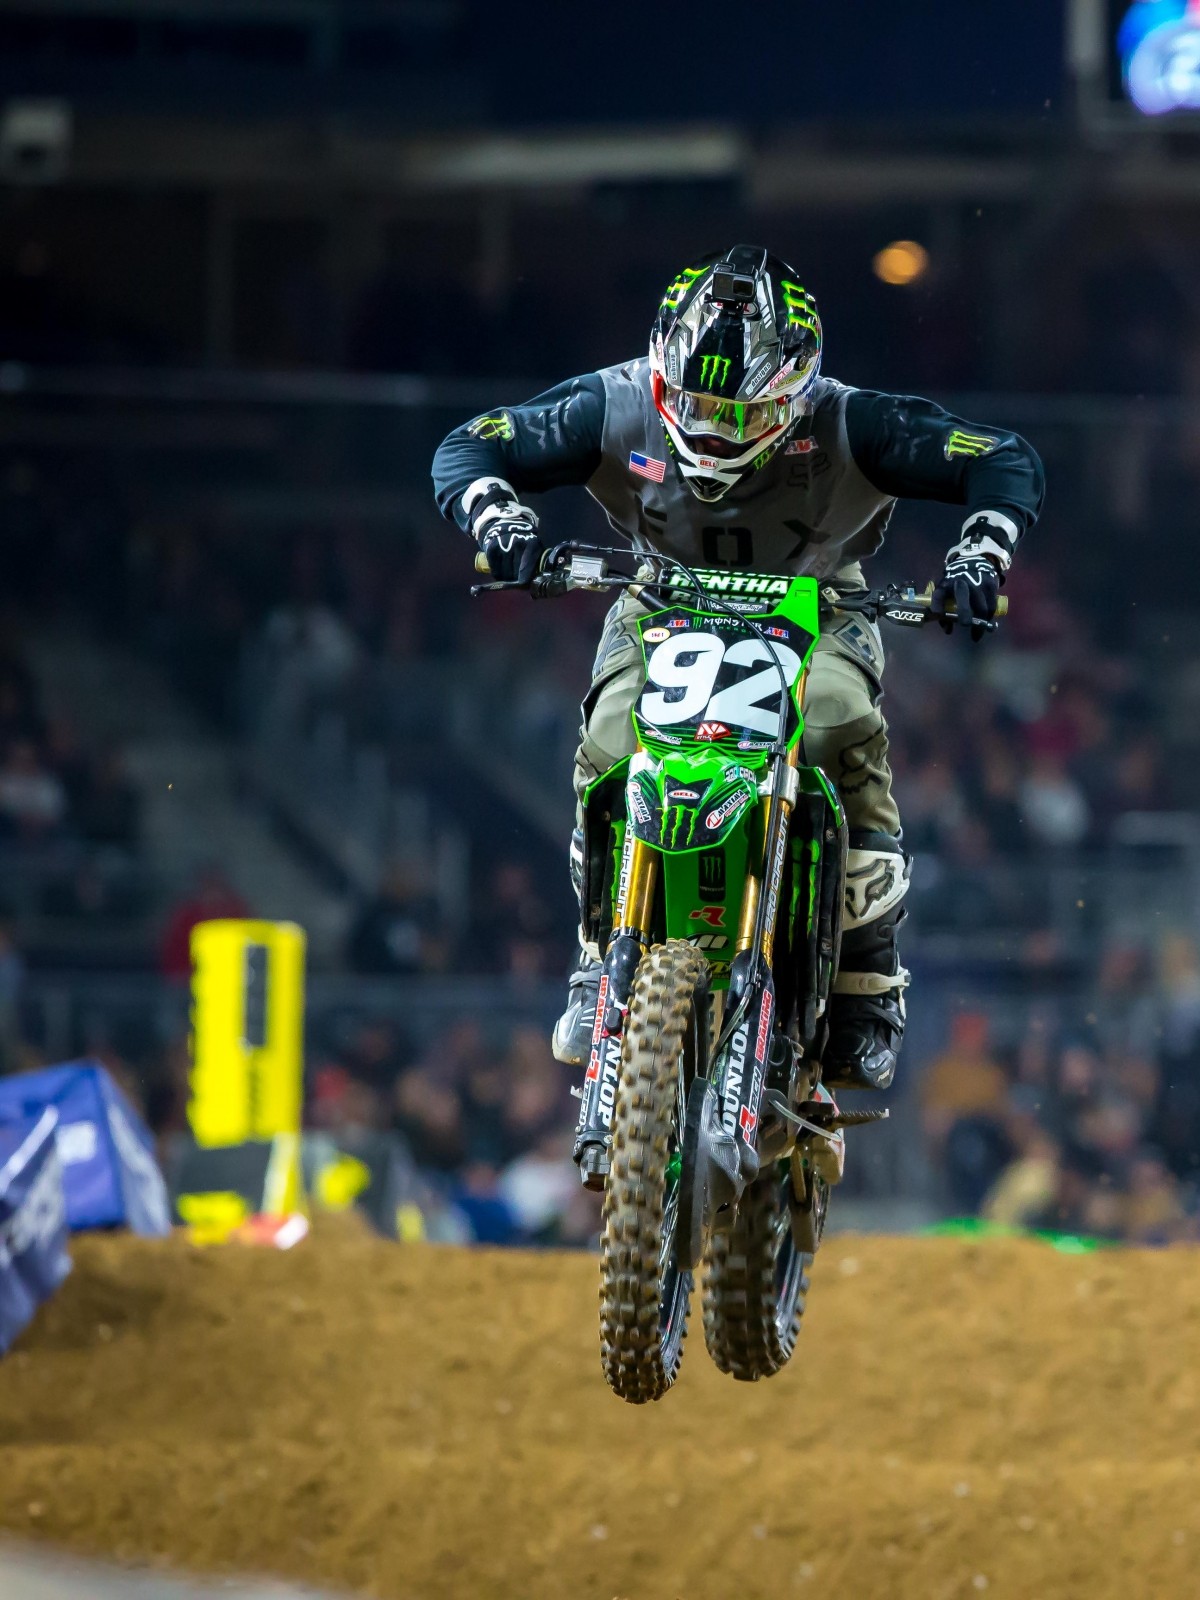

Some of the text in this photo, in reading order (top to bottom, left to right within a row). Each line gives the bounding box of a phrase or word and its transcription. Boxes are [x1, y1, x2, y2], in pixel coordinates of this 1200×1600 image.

[886, 610, 924, 621] ARC
[641, 632, 802, 737] 92
[717, 789, 745, 817] MAXIMA
[614, 841, 634, 921] CIRCUIT
[771, 811, 790, 890] CIRCUIT
[592, 975, 609, 1046] BRAKING
[755, 989, 773, 1065] BRAKING
